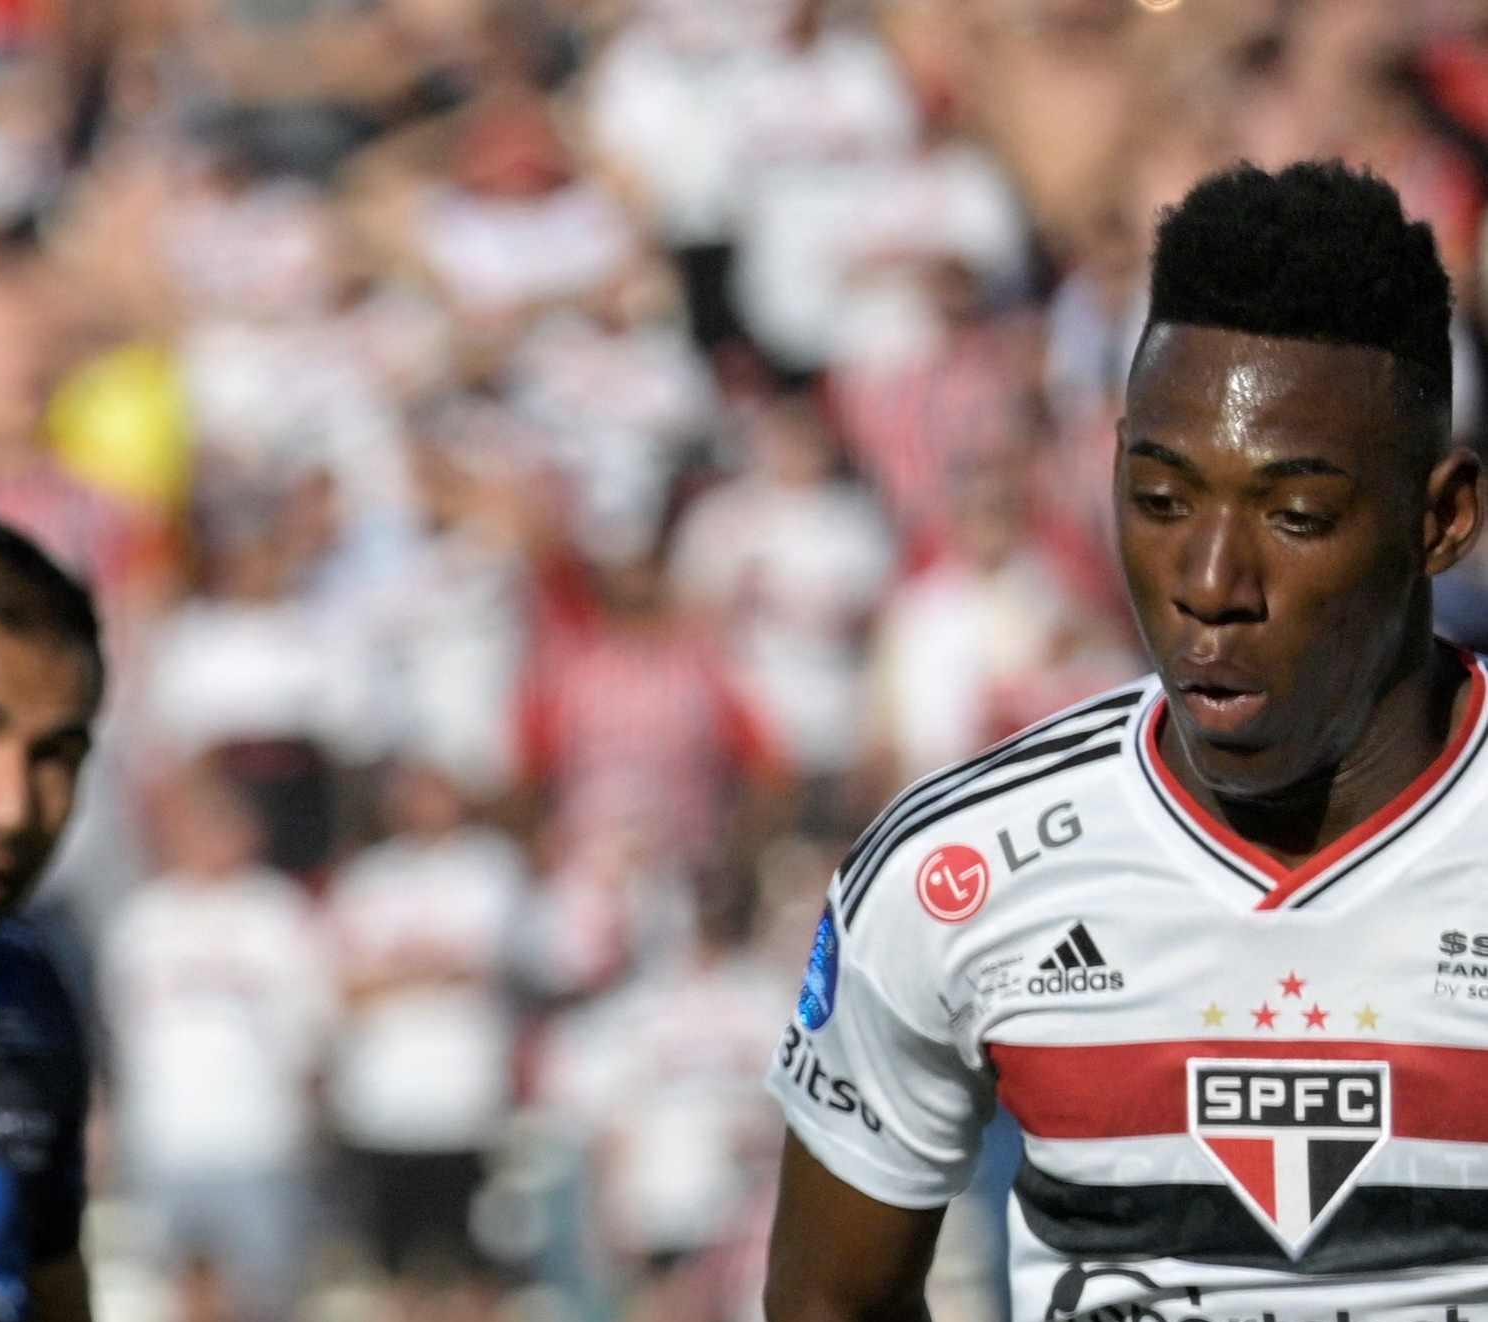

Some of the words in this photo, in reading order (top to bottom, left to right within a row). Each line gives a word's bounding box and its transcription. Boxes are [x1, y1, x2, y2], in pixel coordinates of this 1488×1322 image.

[997, 799, 1084, 873] LG
[1027, 967, 1125, 996] adidas
[1437, 961, 1488, 977] FAN
[1203, 1074, 1376, 1123] SPFC
